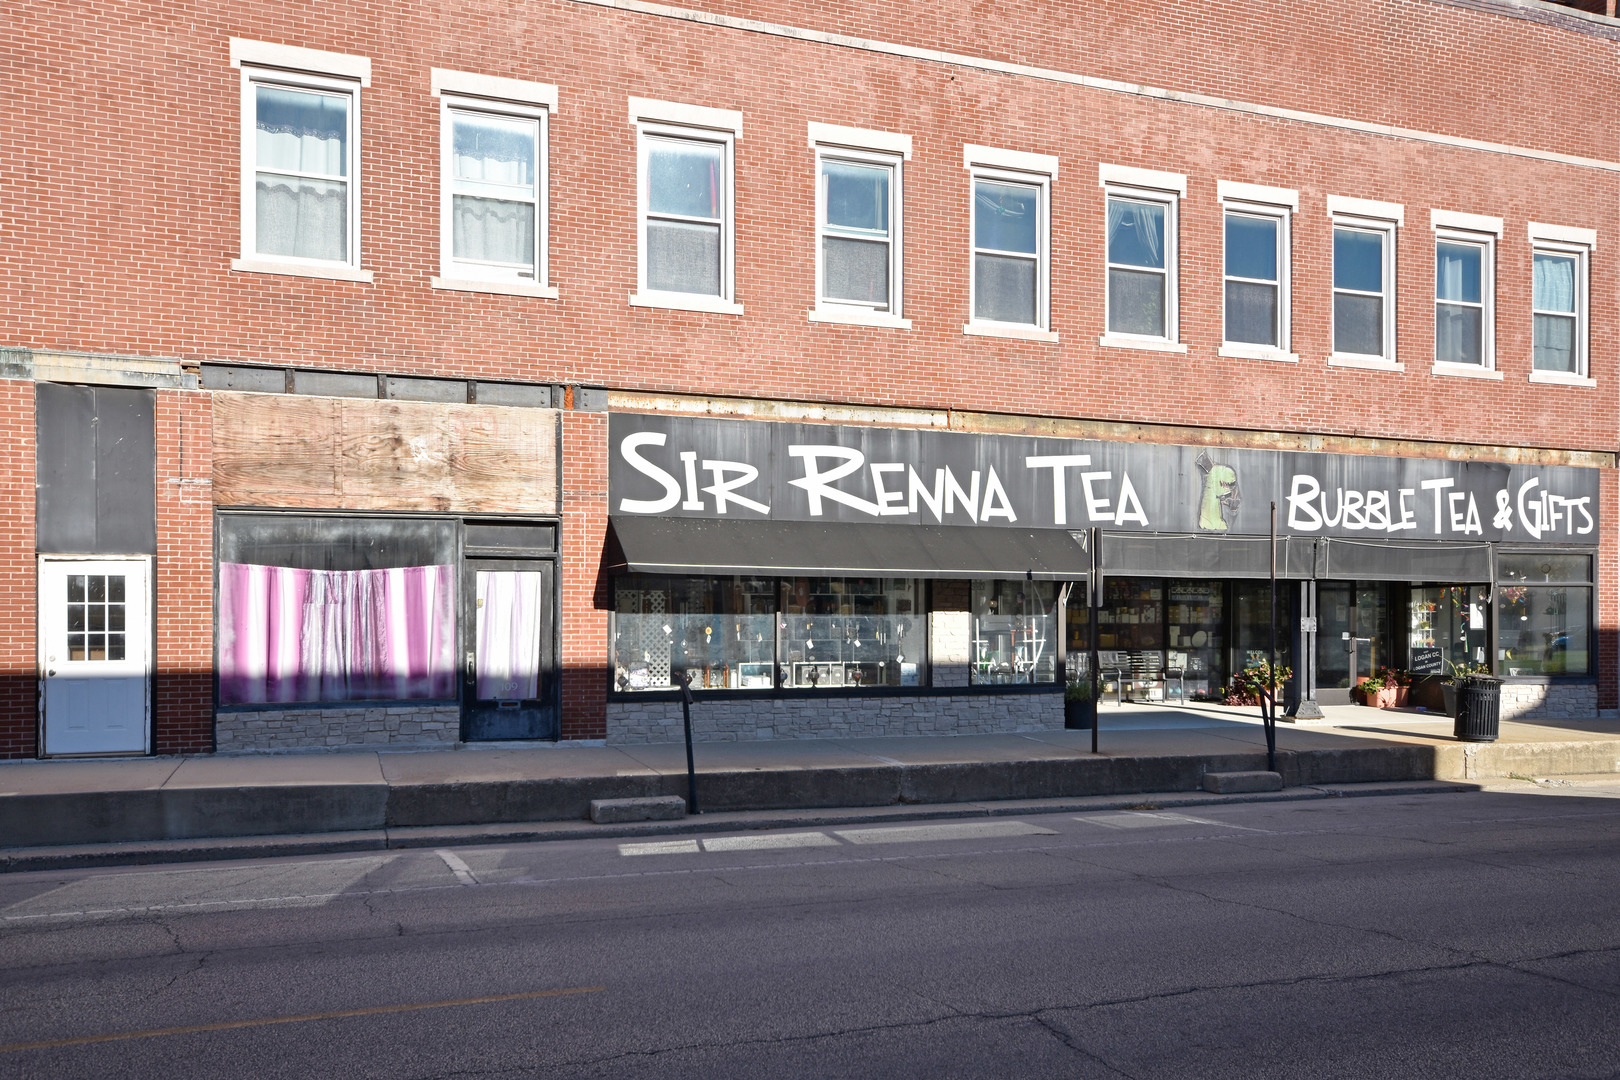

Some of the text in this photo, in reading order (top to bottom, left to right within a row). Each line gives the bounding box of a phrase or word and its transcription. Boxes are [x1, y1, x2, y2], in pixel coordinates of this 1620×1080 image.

[787, 444, 1018, 524] RENNA
[1025, 454, 1150, 527] TEA
[1285, 474, 1595, 540] BUBBLE TEA & GIFTS
[1414, 653, 1432, 662] LOGAN
[501, 681, 518, 692] 109
